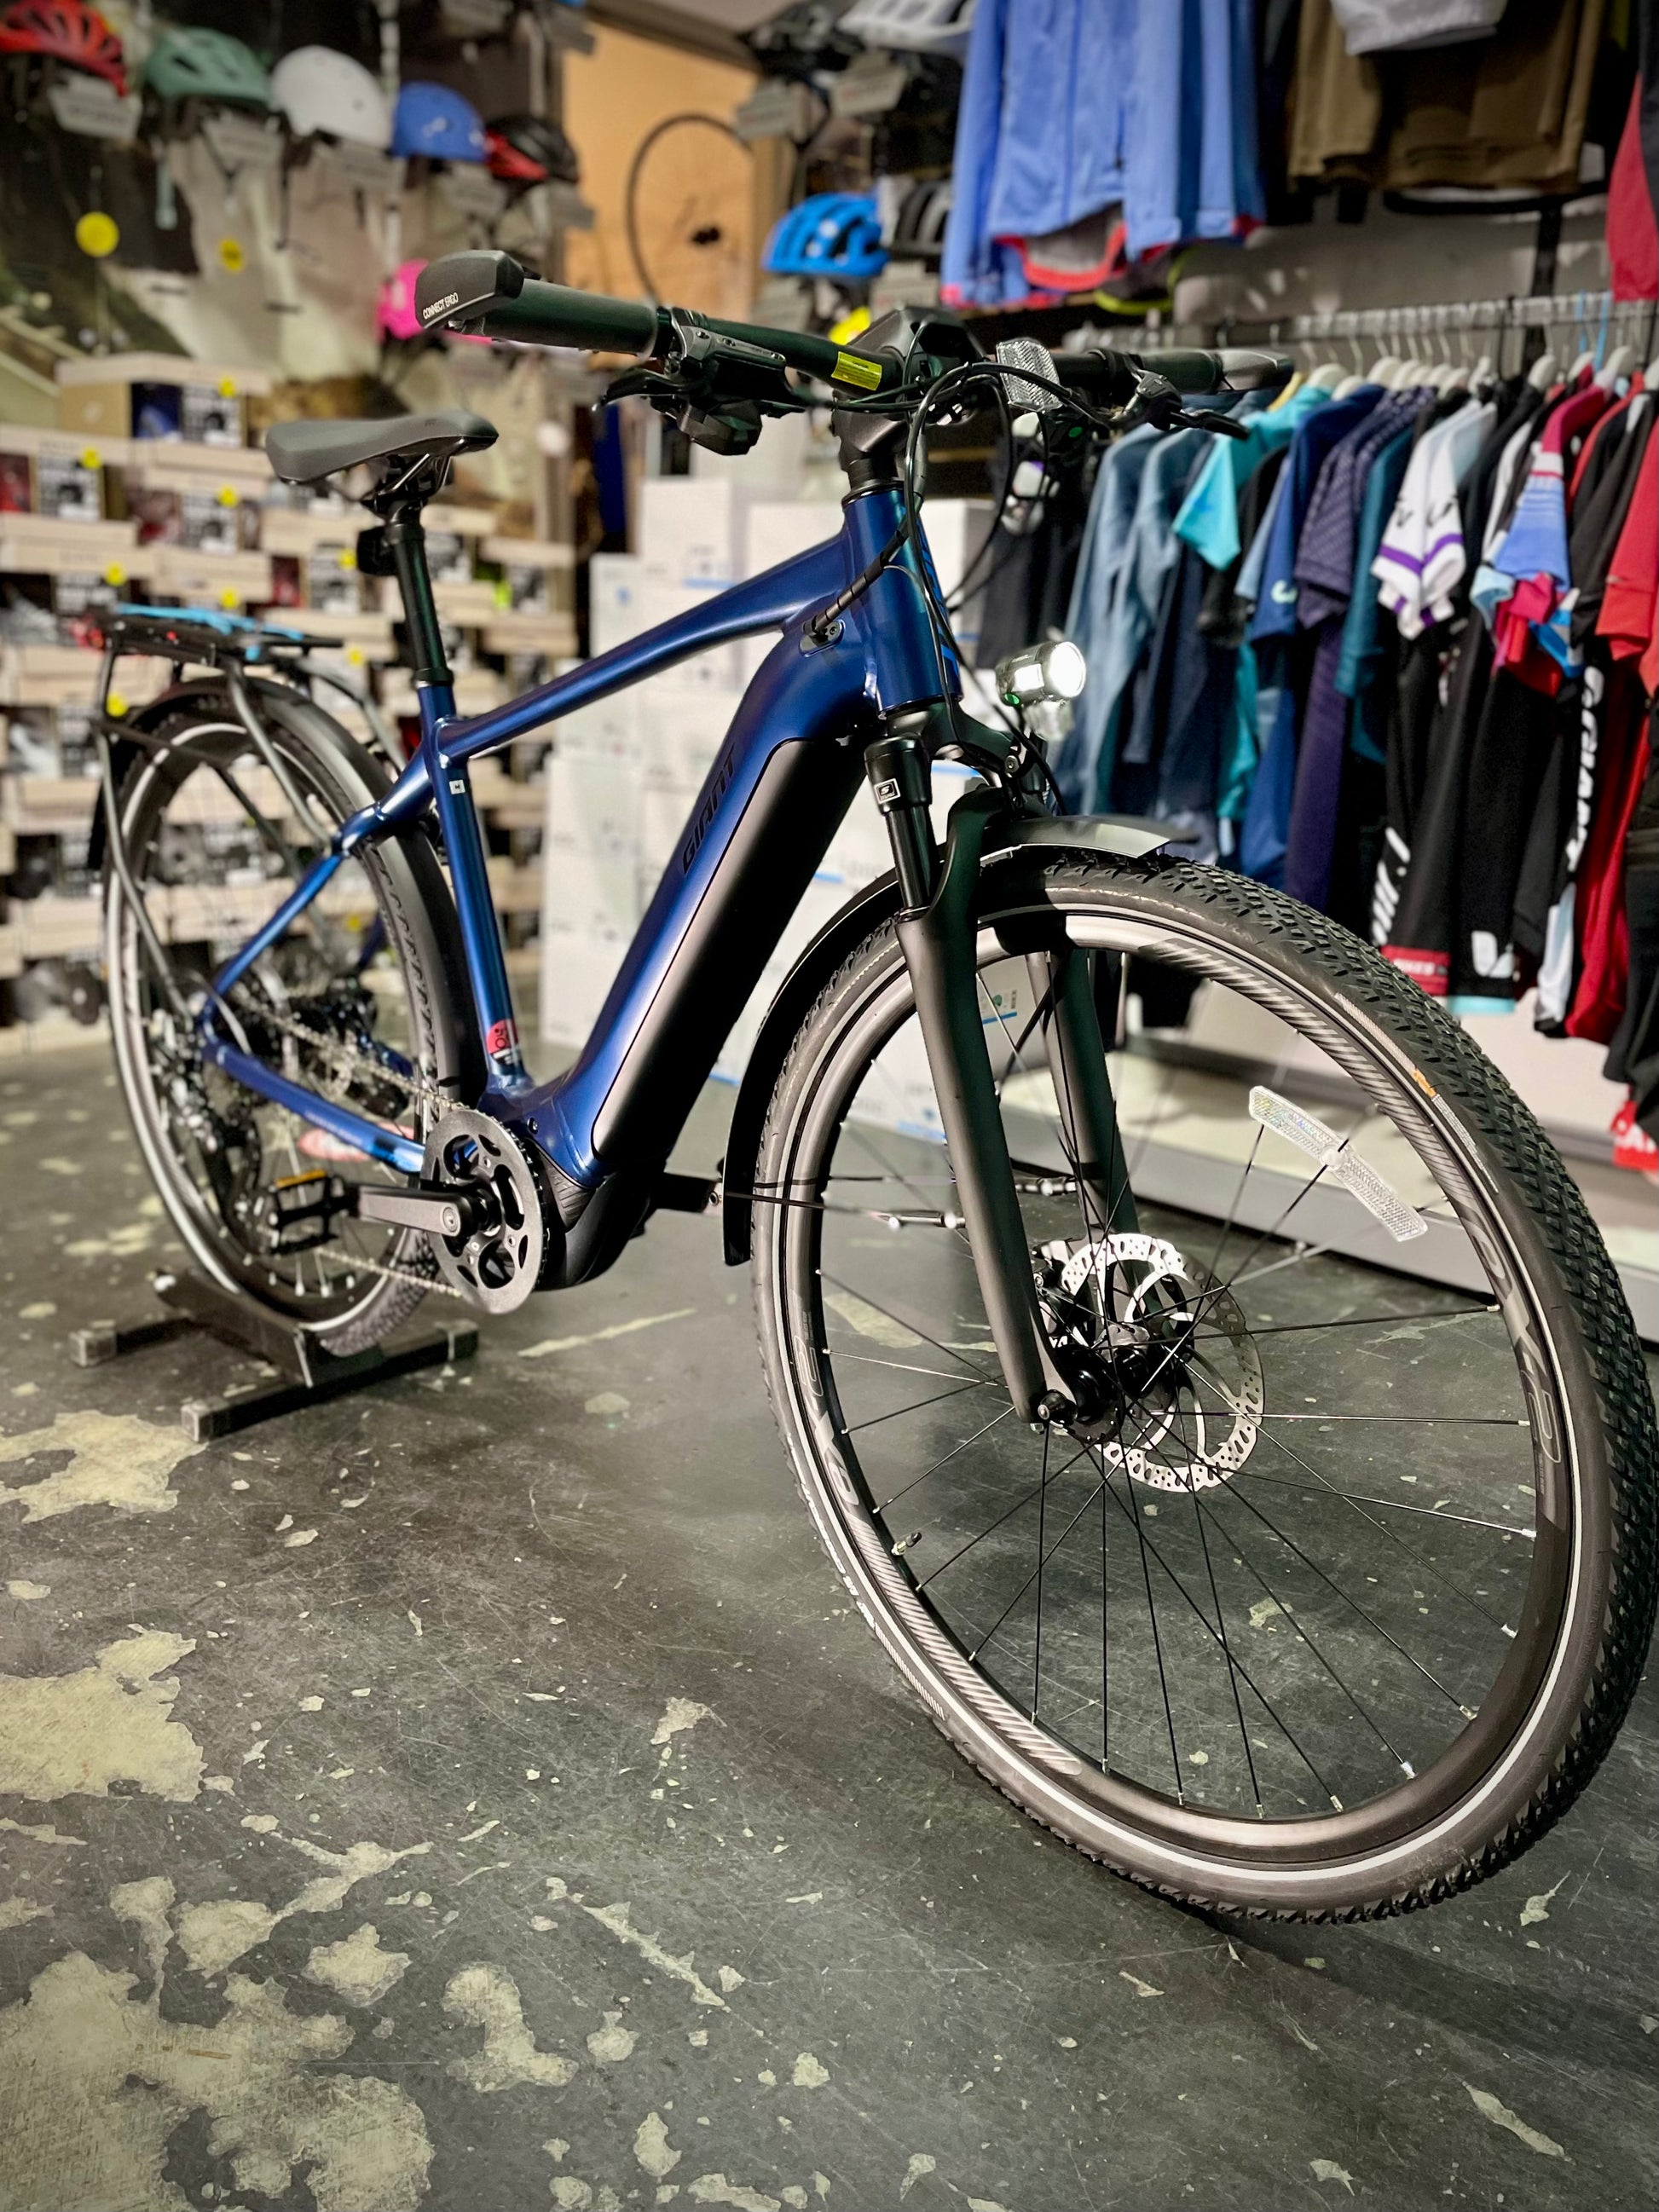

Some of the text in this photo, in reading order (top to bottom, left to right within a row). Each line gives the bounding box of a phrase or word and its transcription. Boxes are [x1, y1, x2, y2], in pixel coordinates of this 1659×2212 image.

[423, 292, 459, 319] CONNECT ERGO
[682, 742, 735, 875] GIANT
